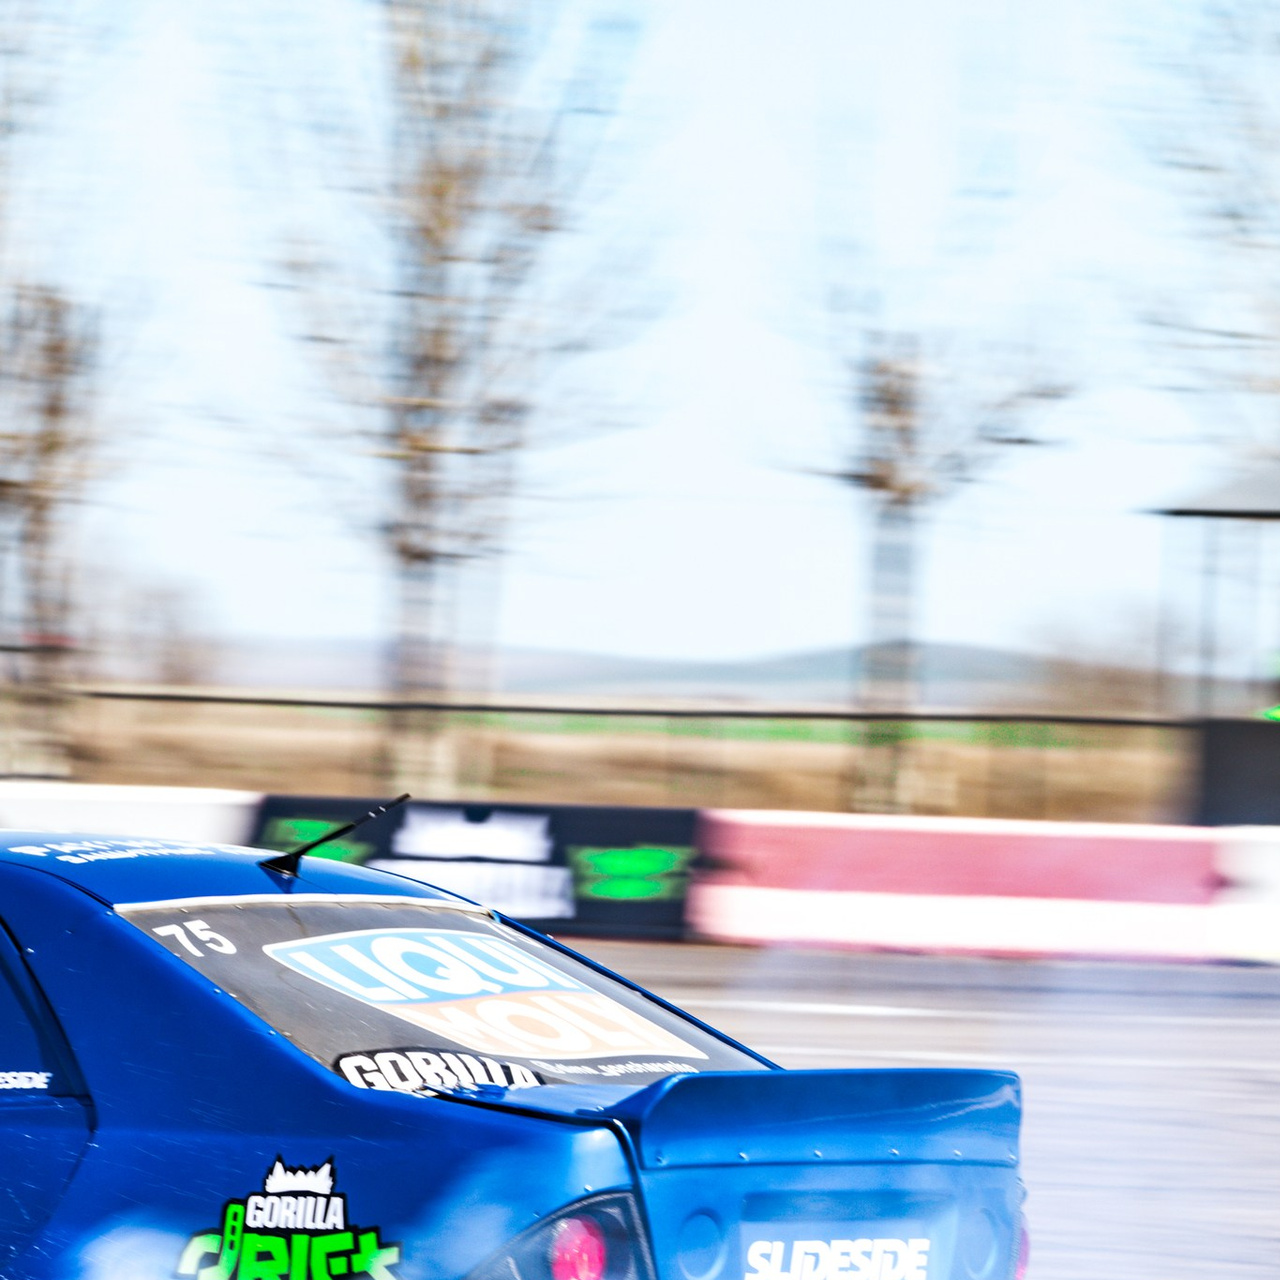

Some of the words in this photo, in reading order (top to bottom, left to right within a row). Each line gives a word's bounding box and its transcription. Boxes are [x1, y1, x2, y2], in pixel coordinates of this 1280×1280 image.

[152, 919, 238, 957] 75
[287, 934, 582, 1000] LIQUI
[397, 993, 678, 1052] MOLY
[245, 1195, 345, 1230] GORILLA
